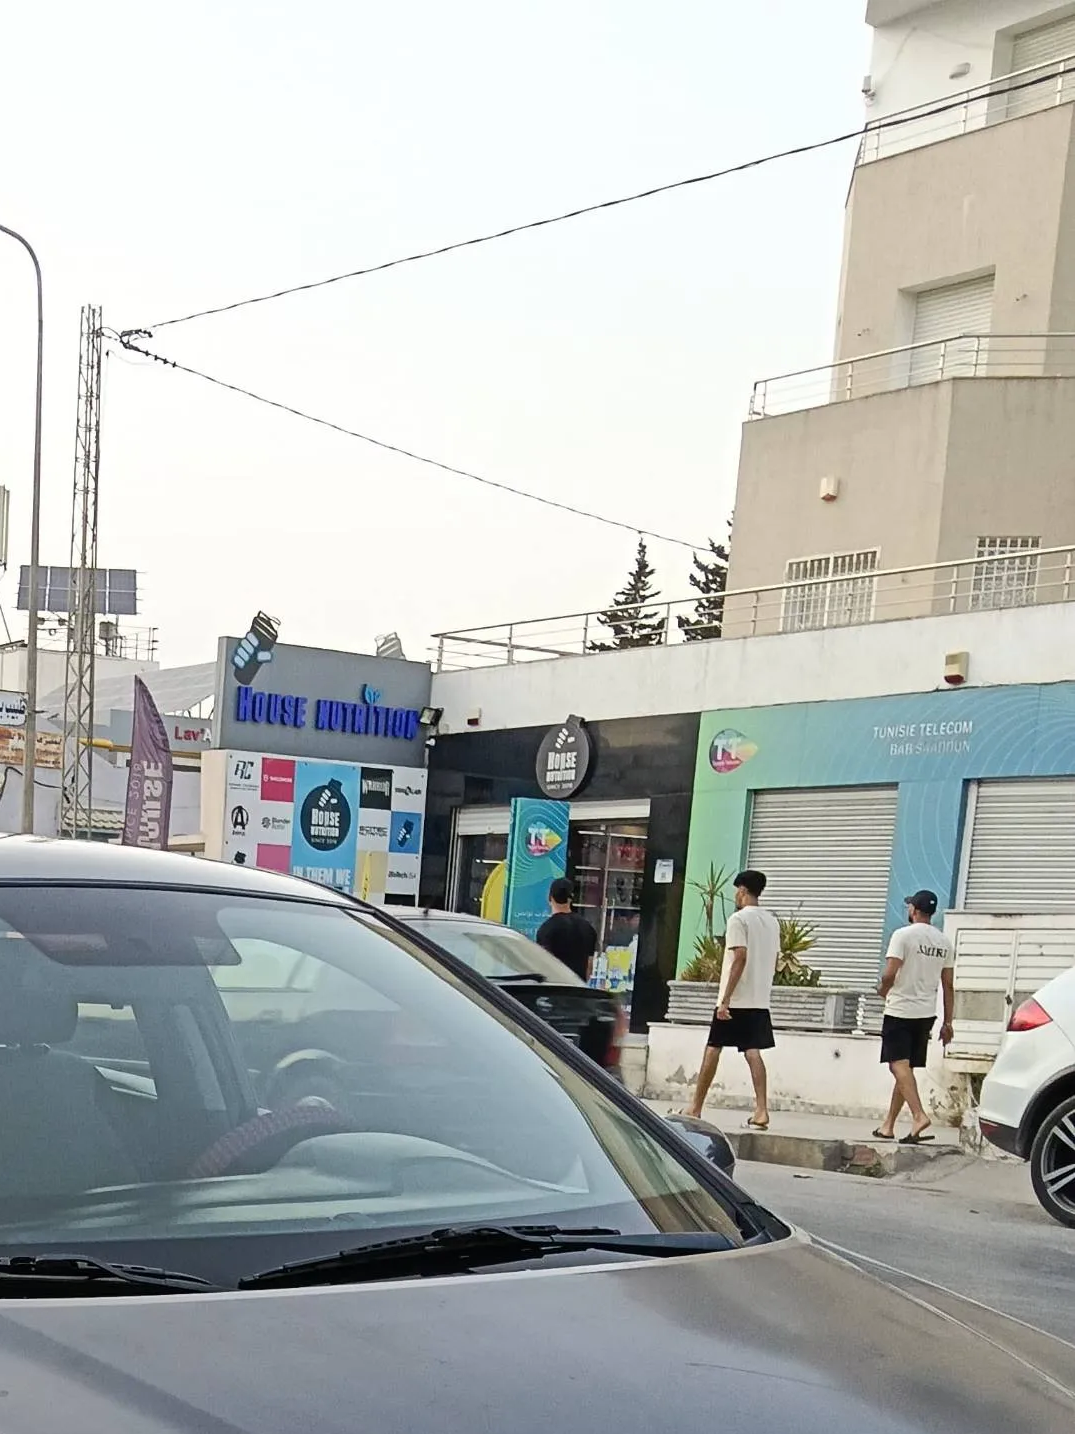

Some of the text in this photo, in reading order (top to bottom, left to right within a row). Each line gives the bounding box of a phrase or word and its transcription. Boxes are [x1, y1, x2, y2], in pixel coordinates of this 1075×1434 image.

[236, 685, 419, 741] HOUSE NUTRITION
[873, 720, 973, 739] TUNISIE TELECOM
[890, 743, 913, 756] BAB
[311, 808, 340, 827] HOUSE
